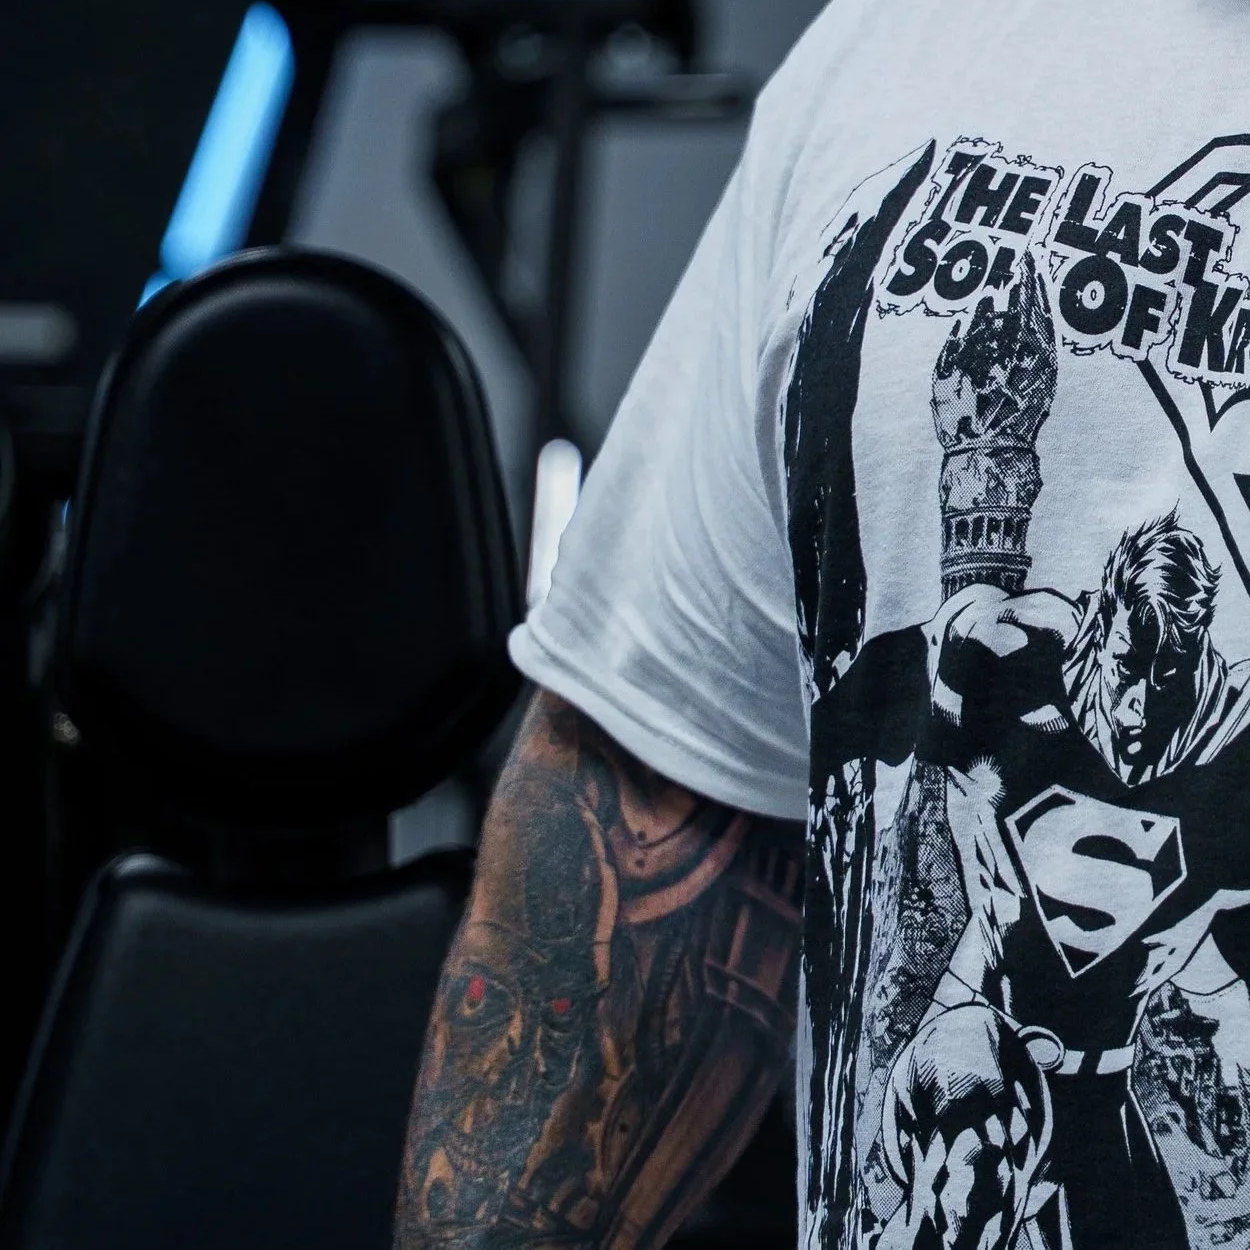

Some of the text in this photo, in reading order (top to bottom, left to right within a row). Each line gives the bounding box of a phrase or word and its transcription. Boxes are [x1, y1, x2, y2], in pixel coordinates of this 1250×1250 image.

[928, 151, 1224, 288] THE LAST
[1059, 255, 1167, 350] OF
